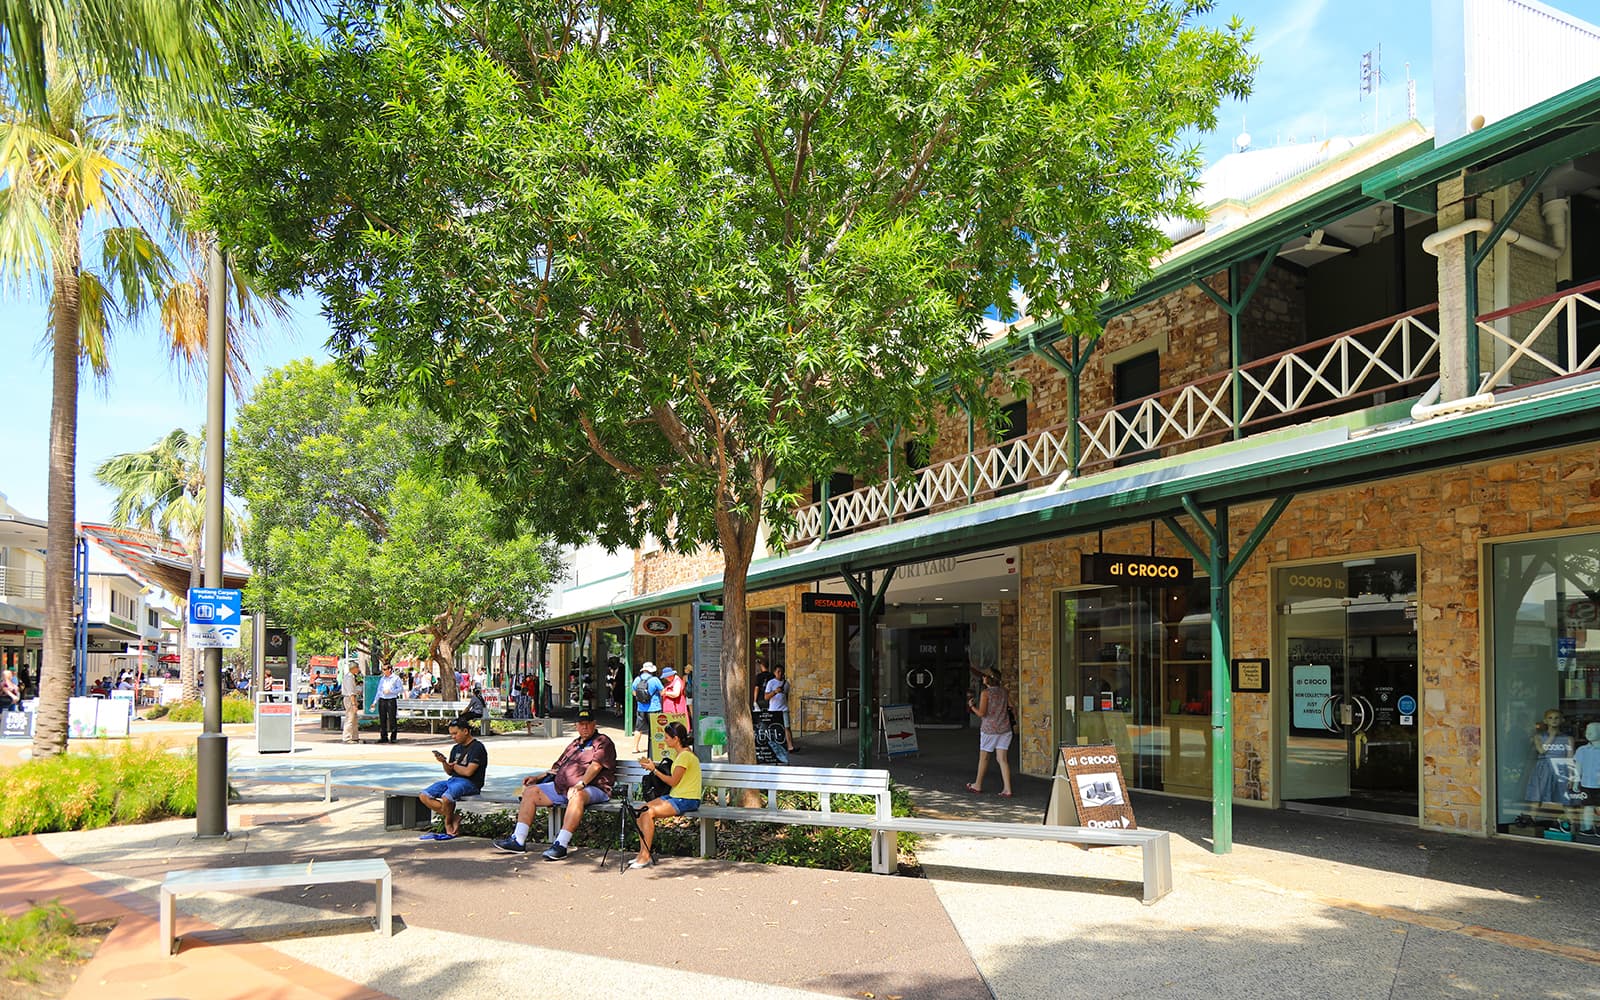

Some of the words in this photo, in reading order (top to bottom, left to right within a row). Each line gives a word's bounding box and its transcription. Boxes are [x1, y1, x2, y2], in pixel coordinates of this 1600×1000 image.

[1110, 562, 1123, 575] di
[1128, 563, 1179, 578] CROCO
[1068, 757, 1078, 766] di
[1080, 755, 1117, 766] CROCO
[1087, 819, 1121, 829] Open
